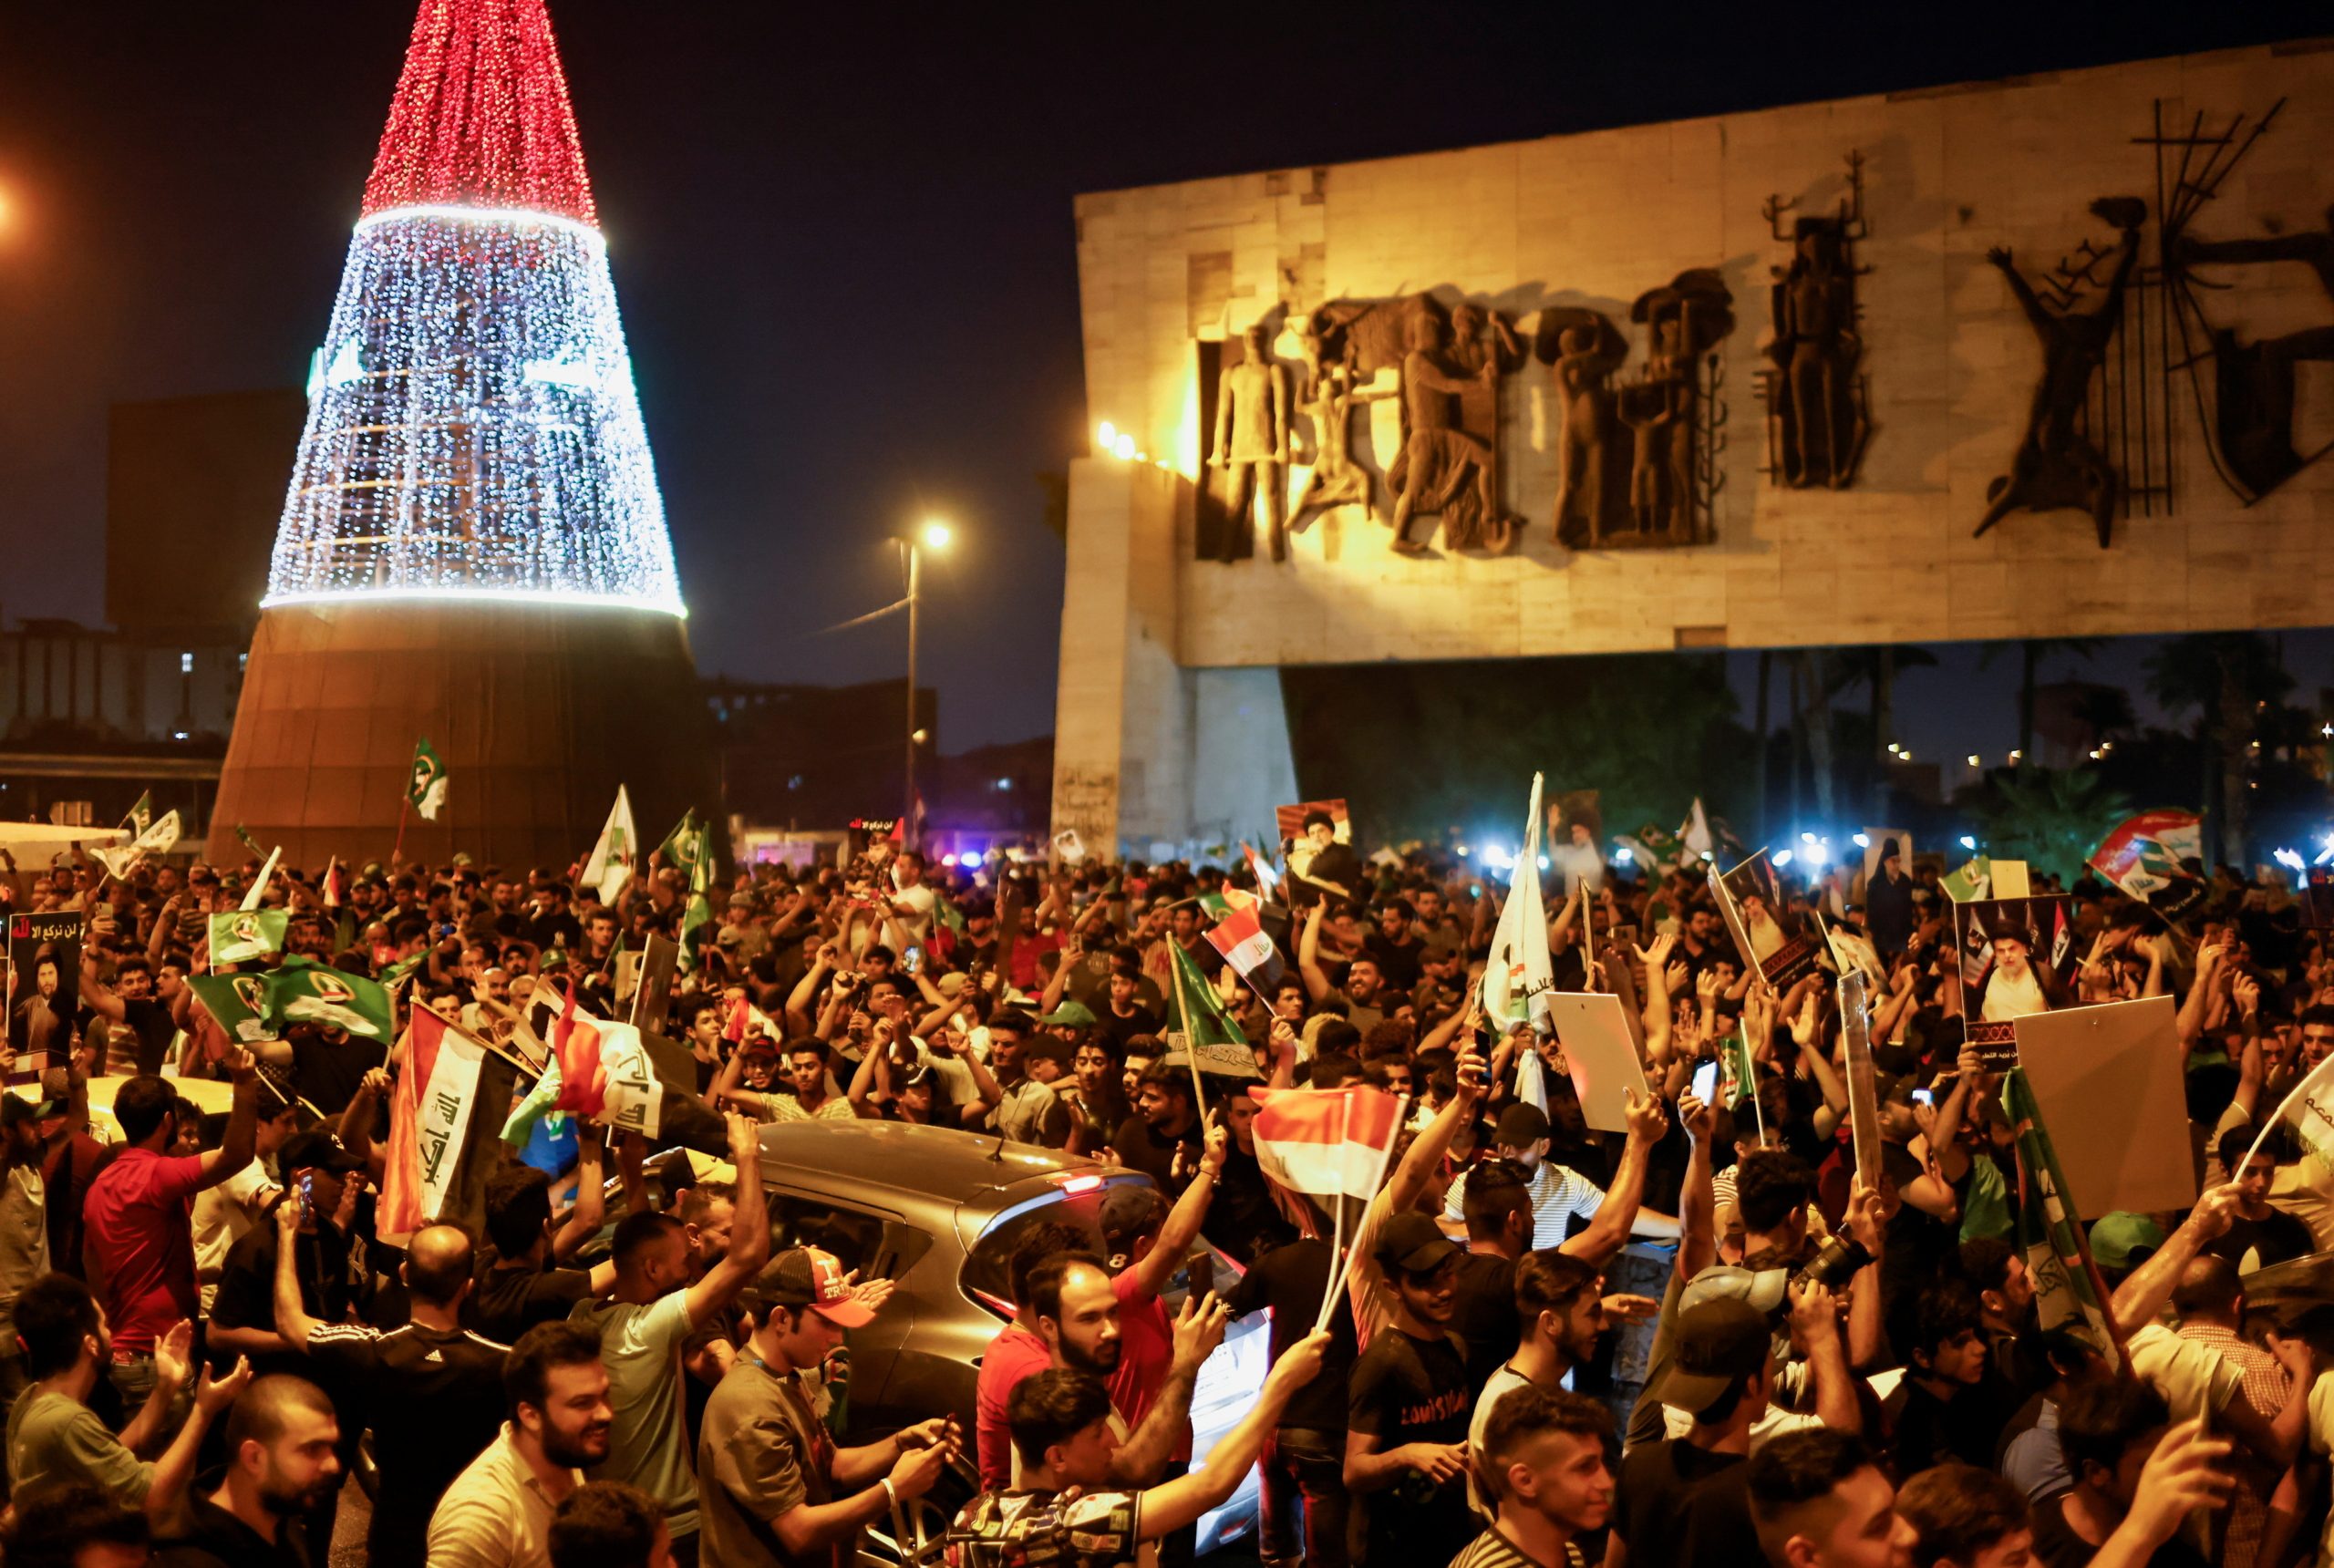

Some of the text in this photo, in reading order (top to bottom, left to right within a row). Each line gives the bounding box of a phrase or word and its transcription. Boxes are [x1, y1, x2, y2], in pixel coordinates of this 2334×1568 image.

[42, 924, 63, 942] نركع
[65, 923, 77, 938] لن
[432, 1091, 461, 1126] الله
